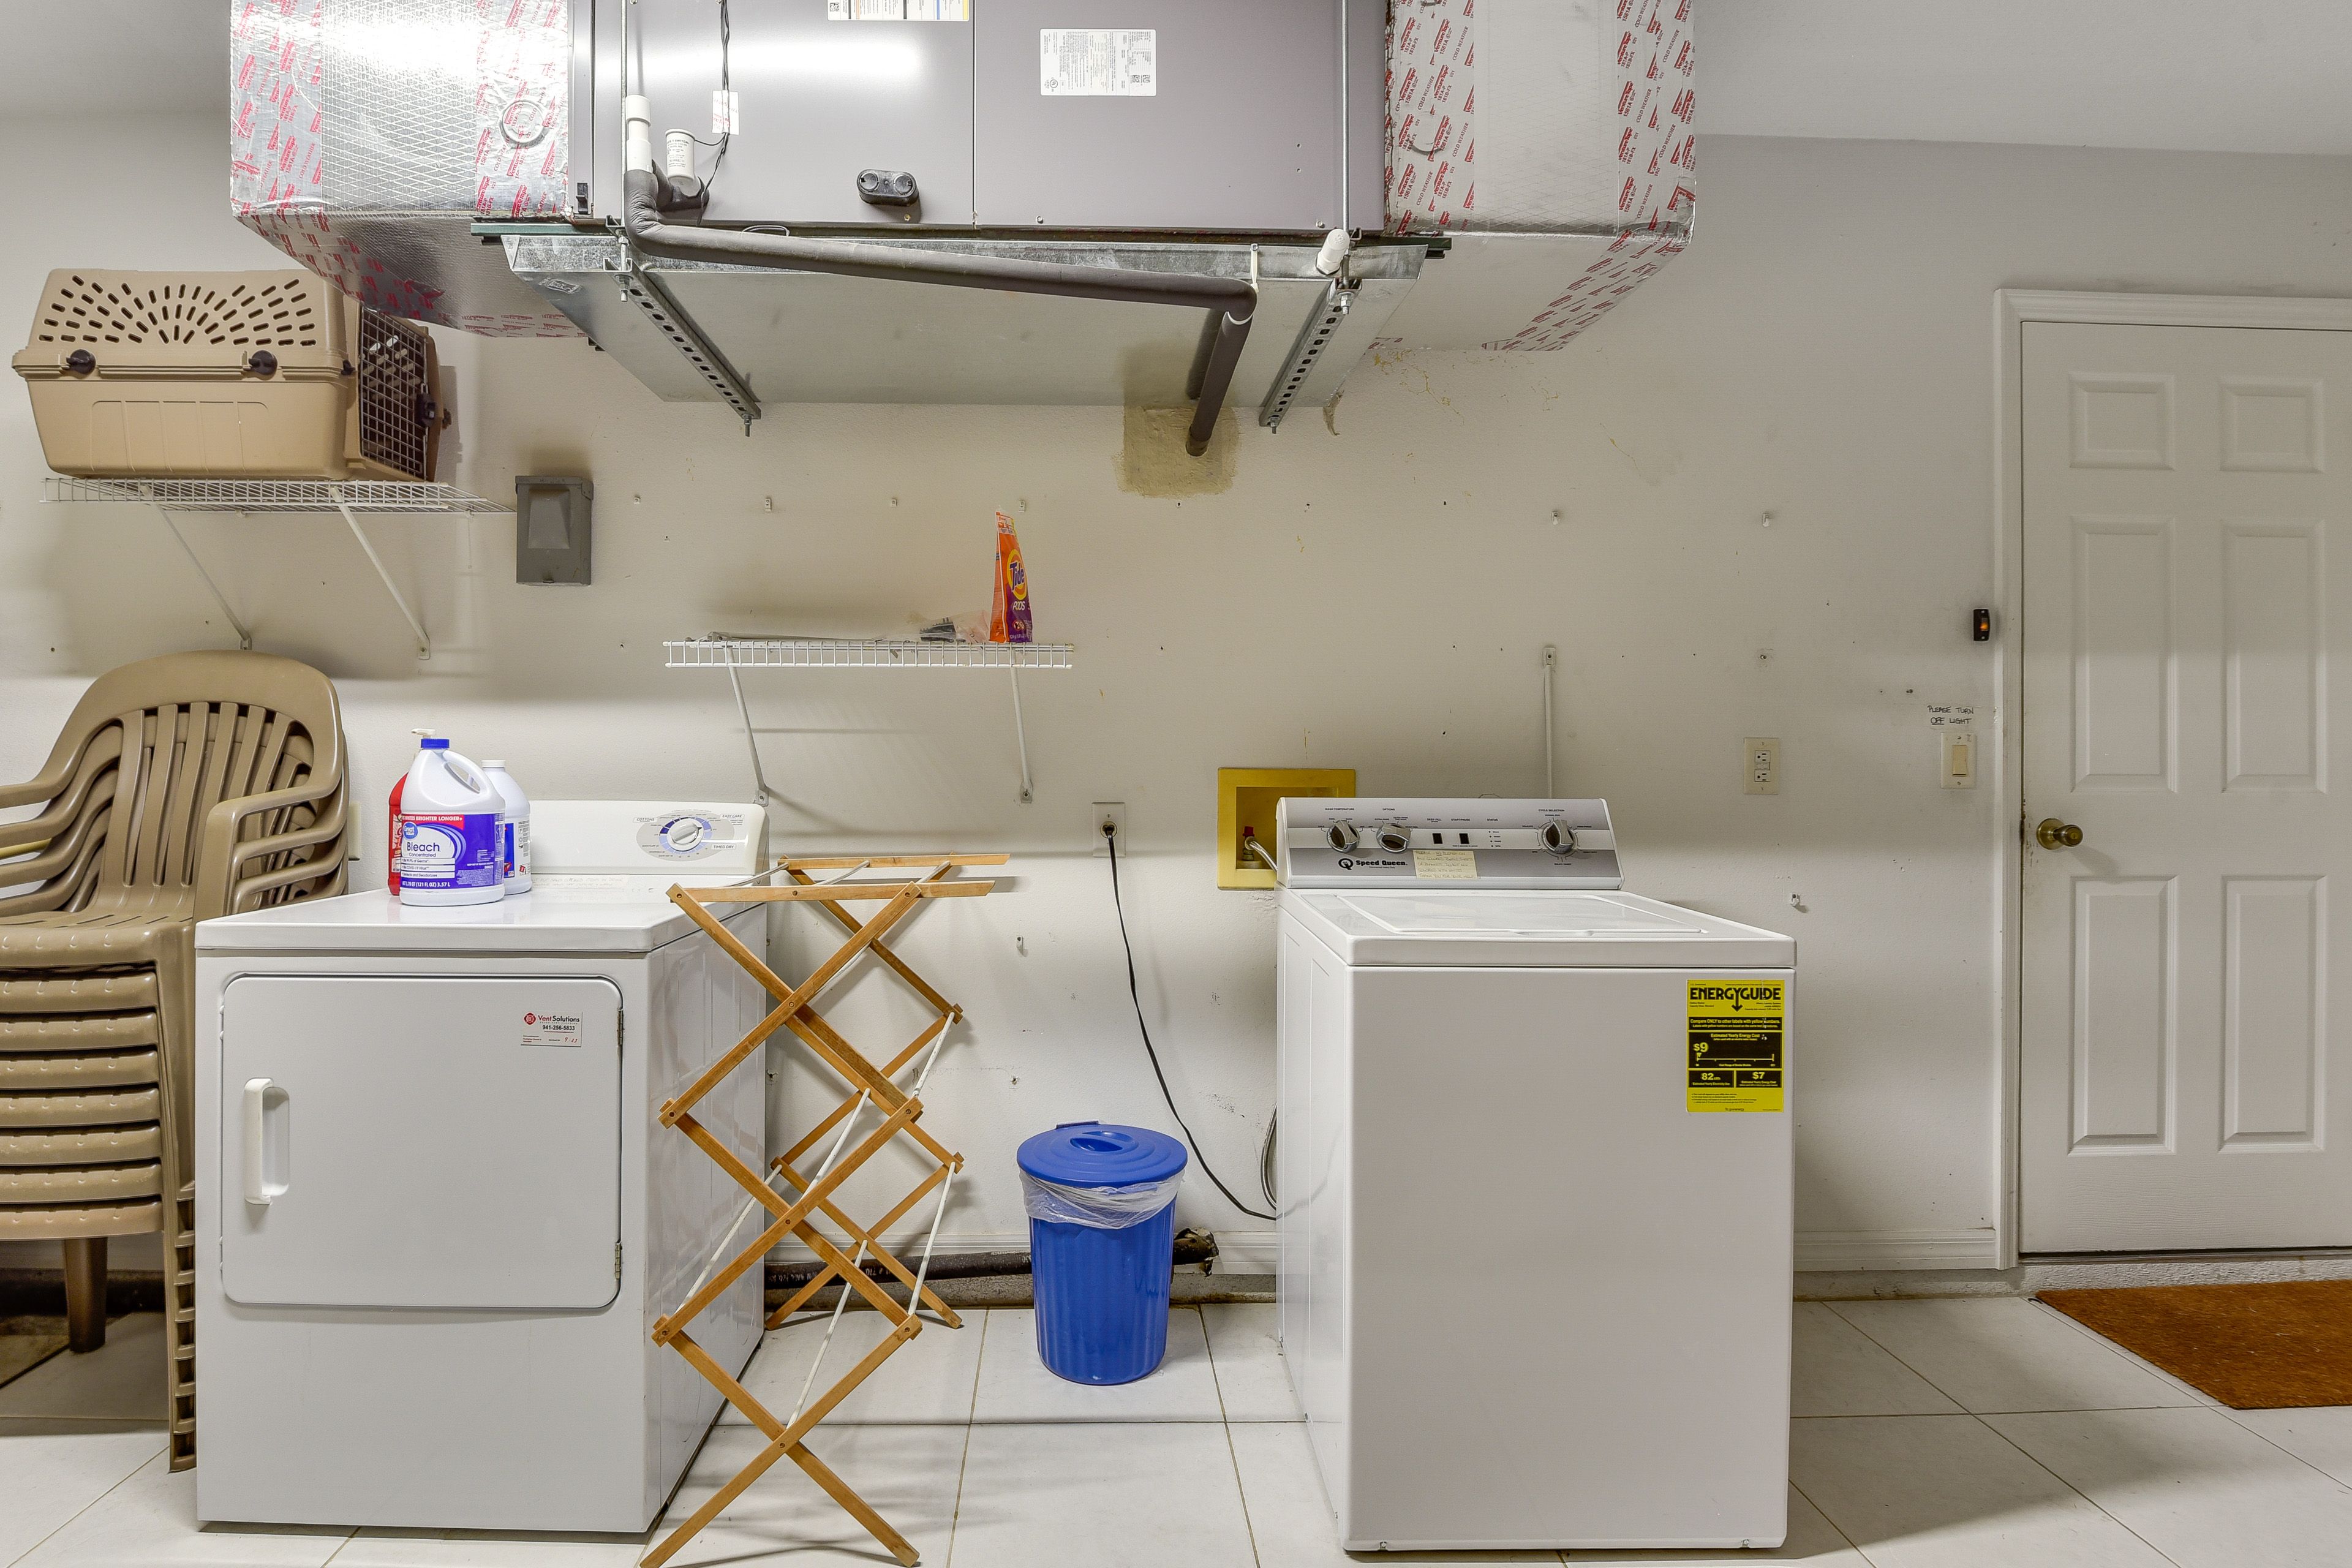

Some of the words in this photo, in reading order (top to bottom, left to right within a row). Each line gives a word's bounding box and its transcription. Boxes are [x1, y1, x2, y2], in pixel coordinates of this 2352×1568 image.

[1009, 562, 1024, 591] Tide
[1012, 601, 1025, 610] PODS
[407, 842, 440, 851] Bleach
[1690, 987, 1781, 1001] ENERGYGUIDE
[1693, 1042, 1708, 1052] $9
